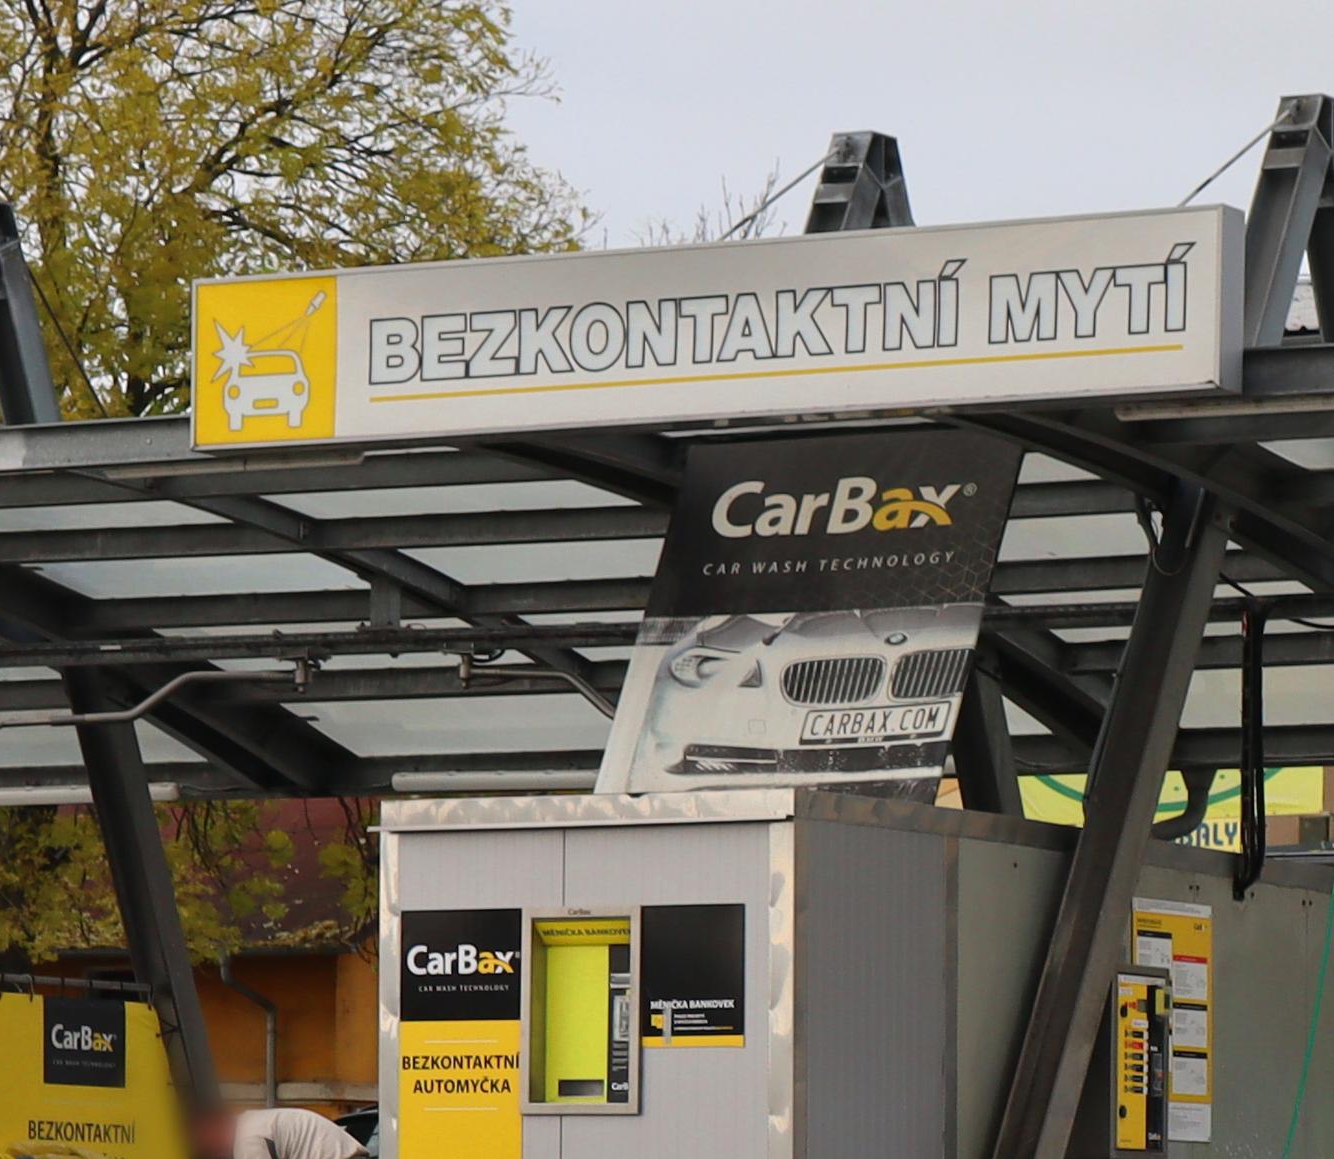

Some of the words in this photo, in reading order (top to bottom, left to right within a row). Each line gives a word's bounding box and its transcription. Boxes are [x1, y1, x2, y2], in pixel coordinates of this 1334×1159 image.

[369, 258, 967, 385] BEZKONTAKTNÍ
[988, 242, 1196, 345] MYTÍ
[702, 563, 741, 576] CAR
[752, 560, 807, 574] WASH
[819, 551, 955, 572] TECHNOLOGY
[809, 707, 939, 737] CARBAX.COM
[402, 1052, 521, 1070] BEZKONTAKTNÍ
[413, 1076, 512, 1094] AUTOMYČKA
[28, 1120, 136, 1144] BEZKONTAKTNÍ
